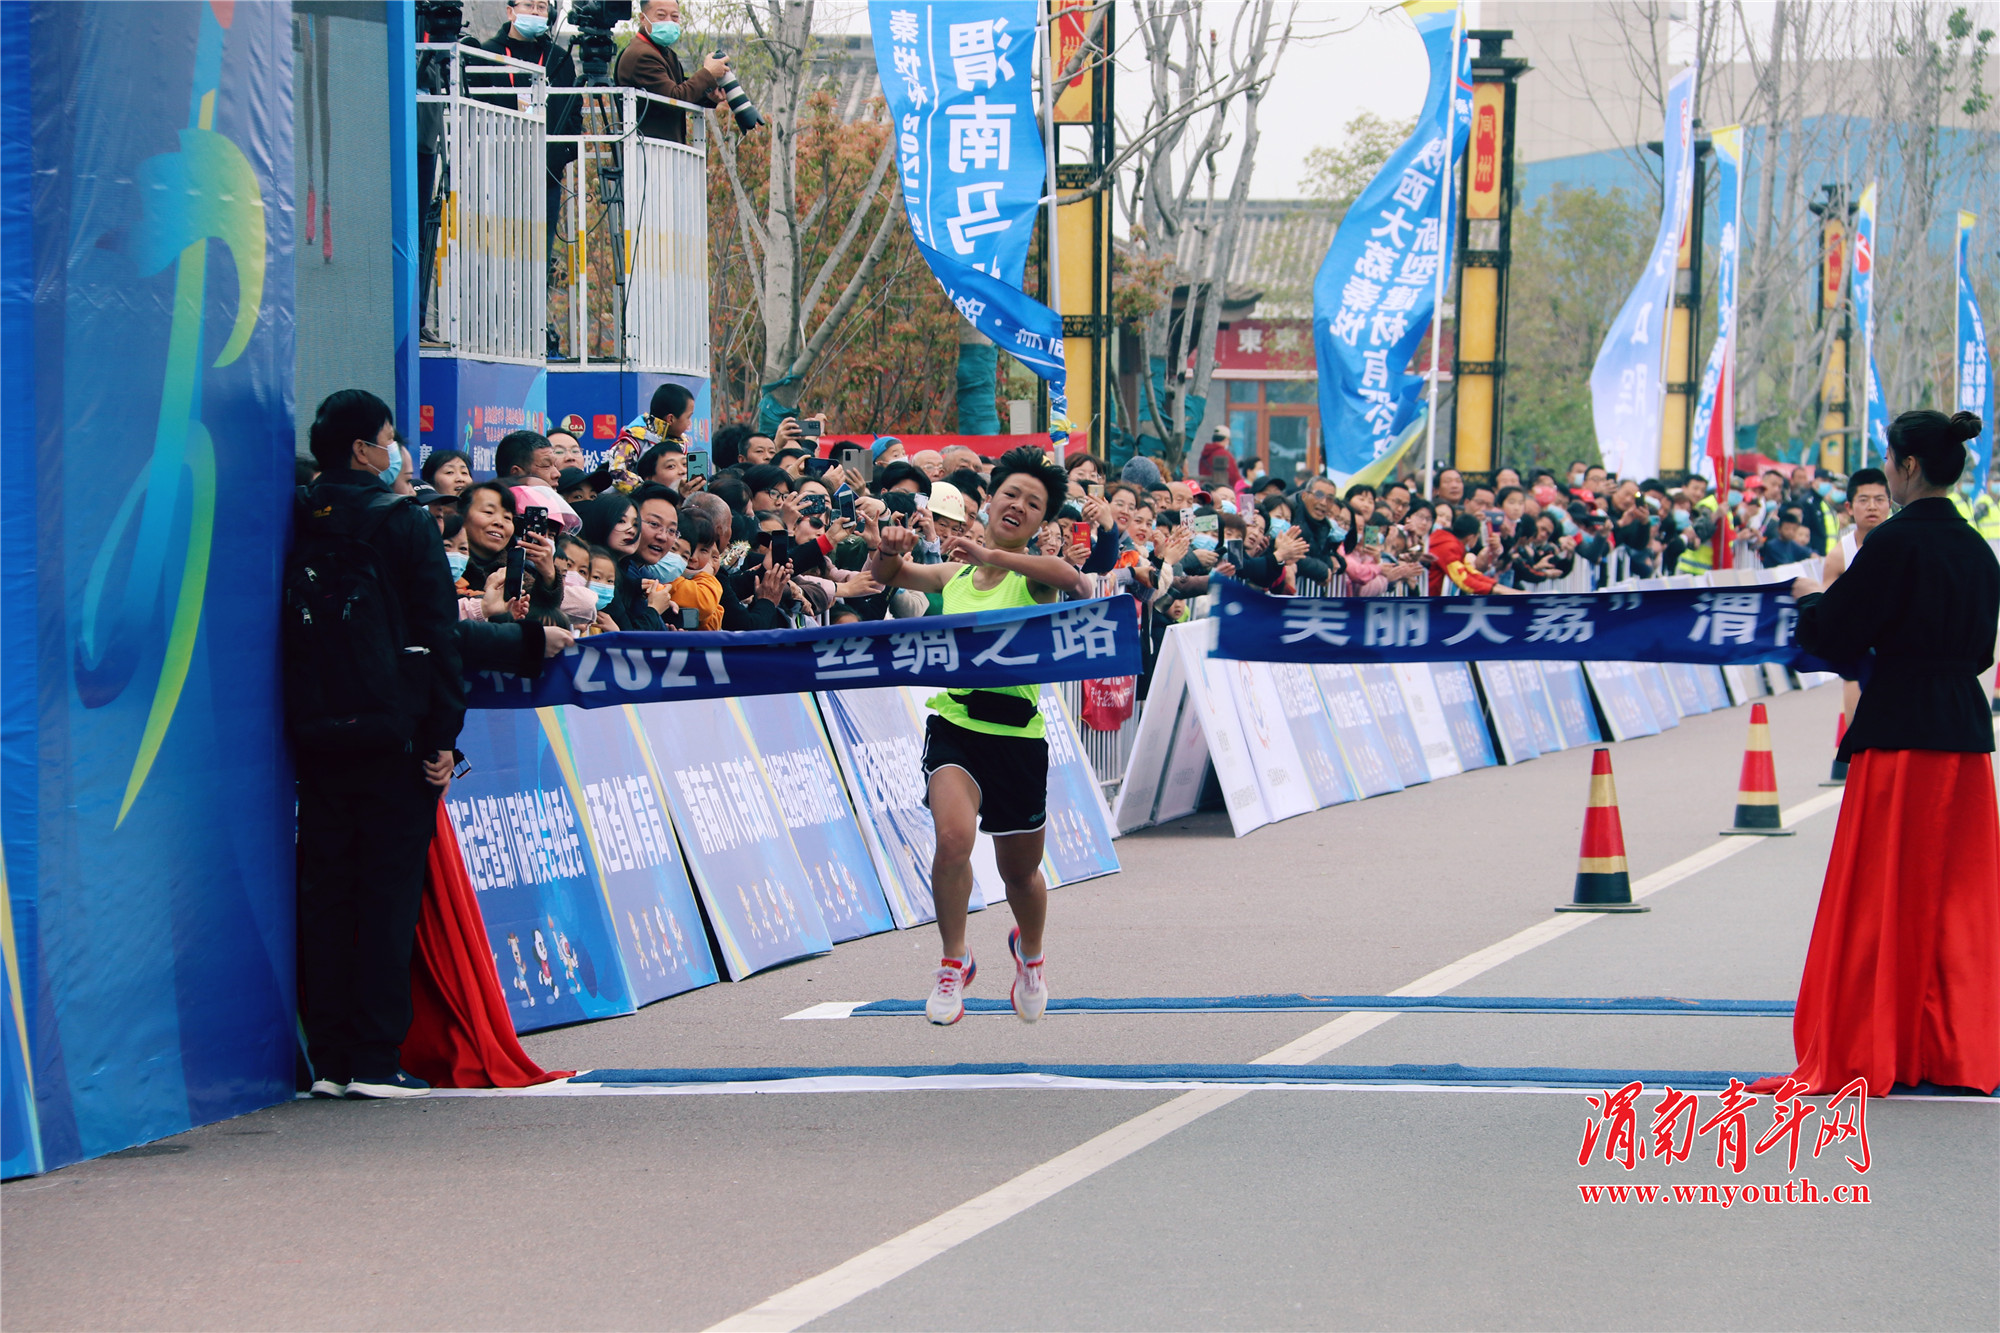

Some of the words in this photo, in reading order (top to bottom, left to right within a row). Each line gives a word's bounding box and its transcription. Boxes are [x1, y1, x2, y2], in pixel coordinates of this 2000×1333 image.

[766, 601, 1119, 681] 丝绸之路
[674, 755, 778, 856] 渭南市人民政府
